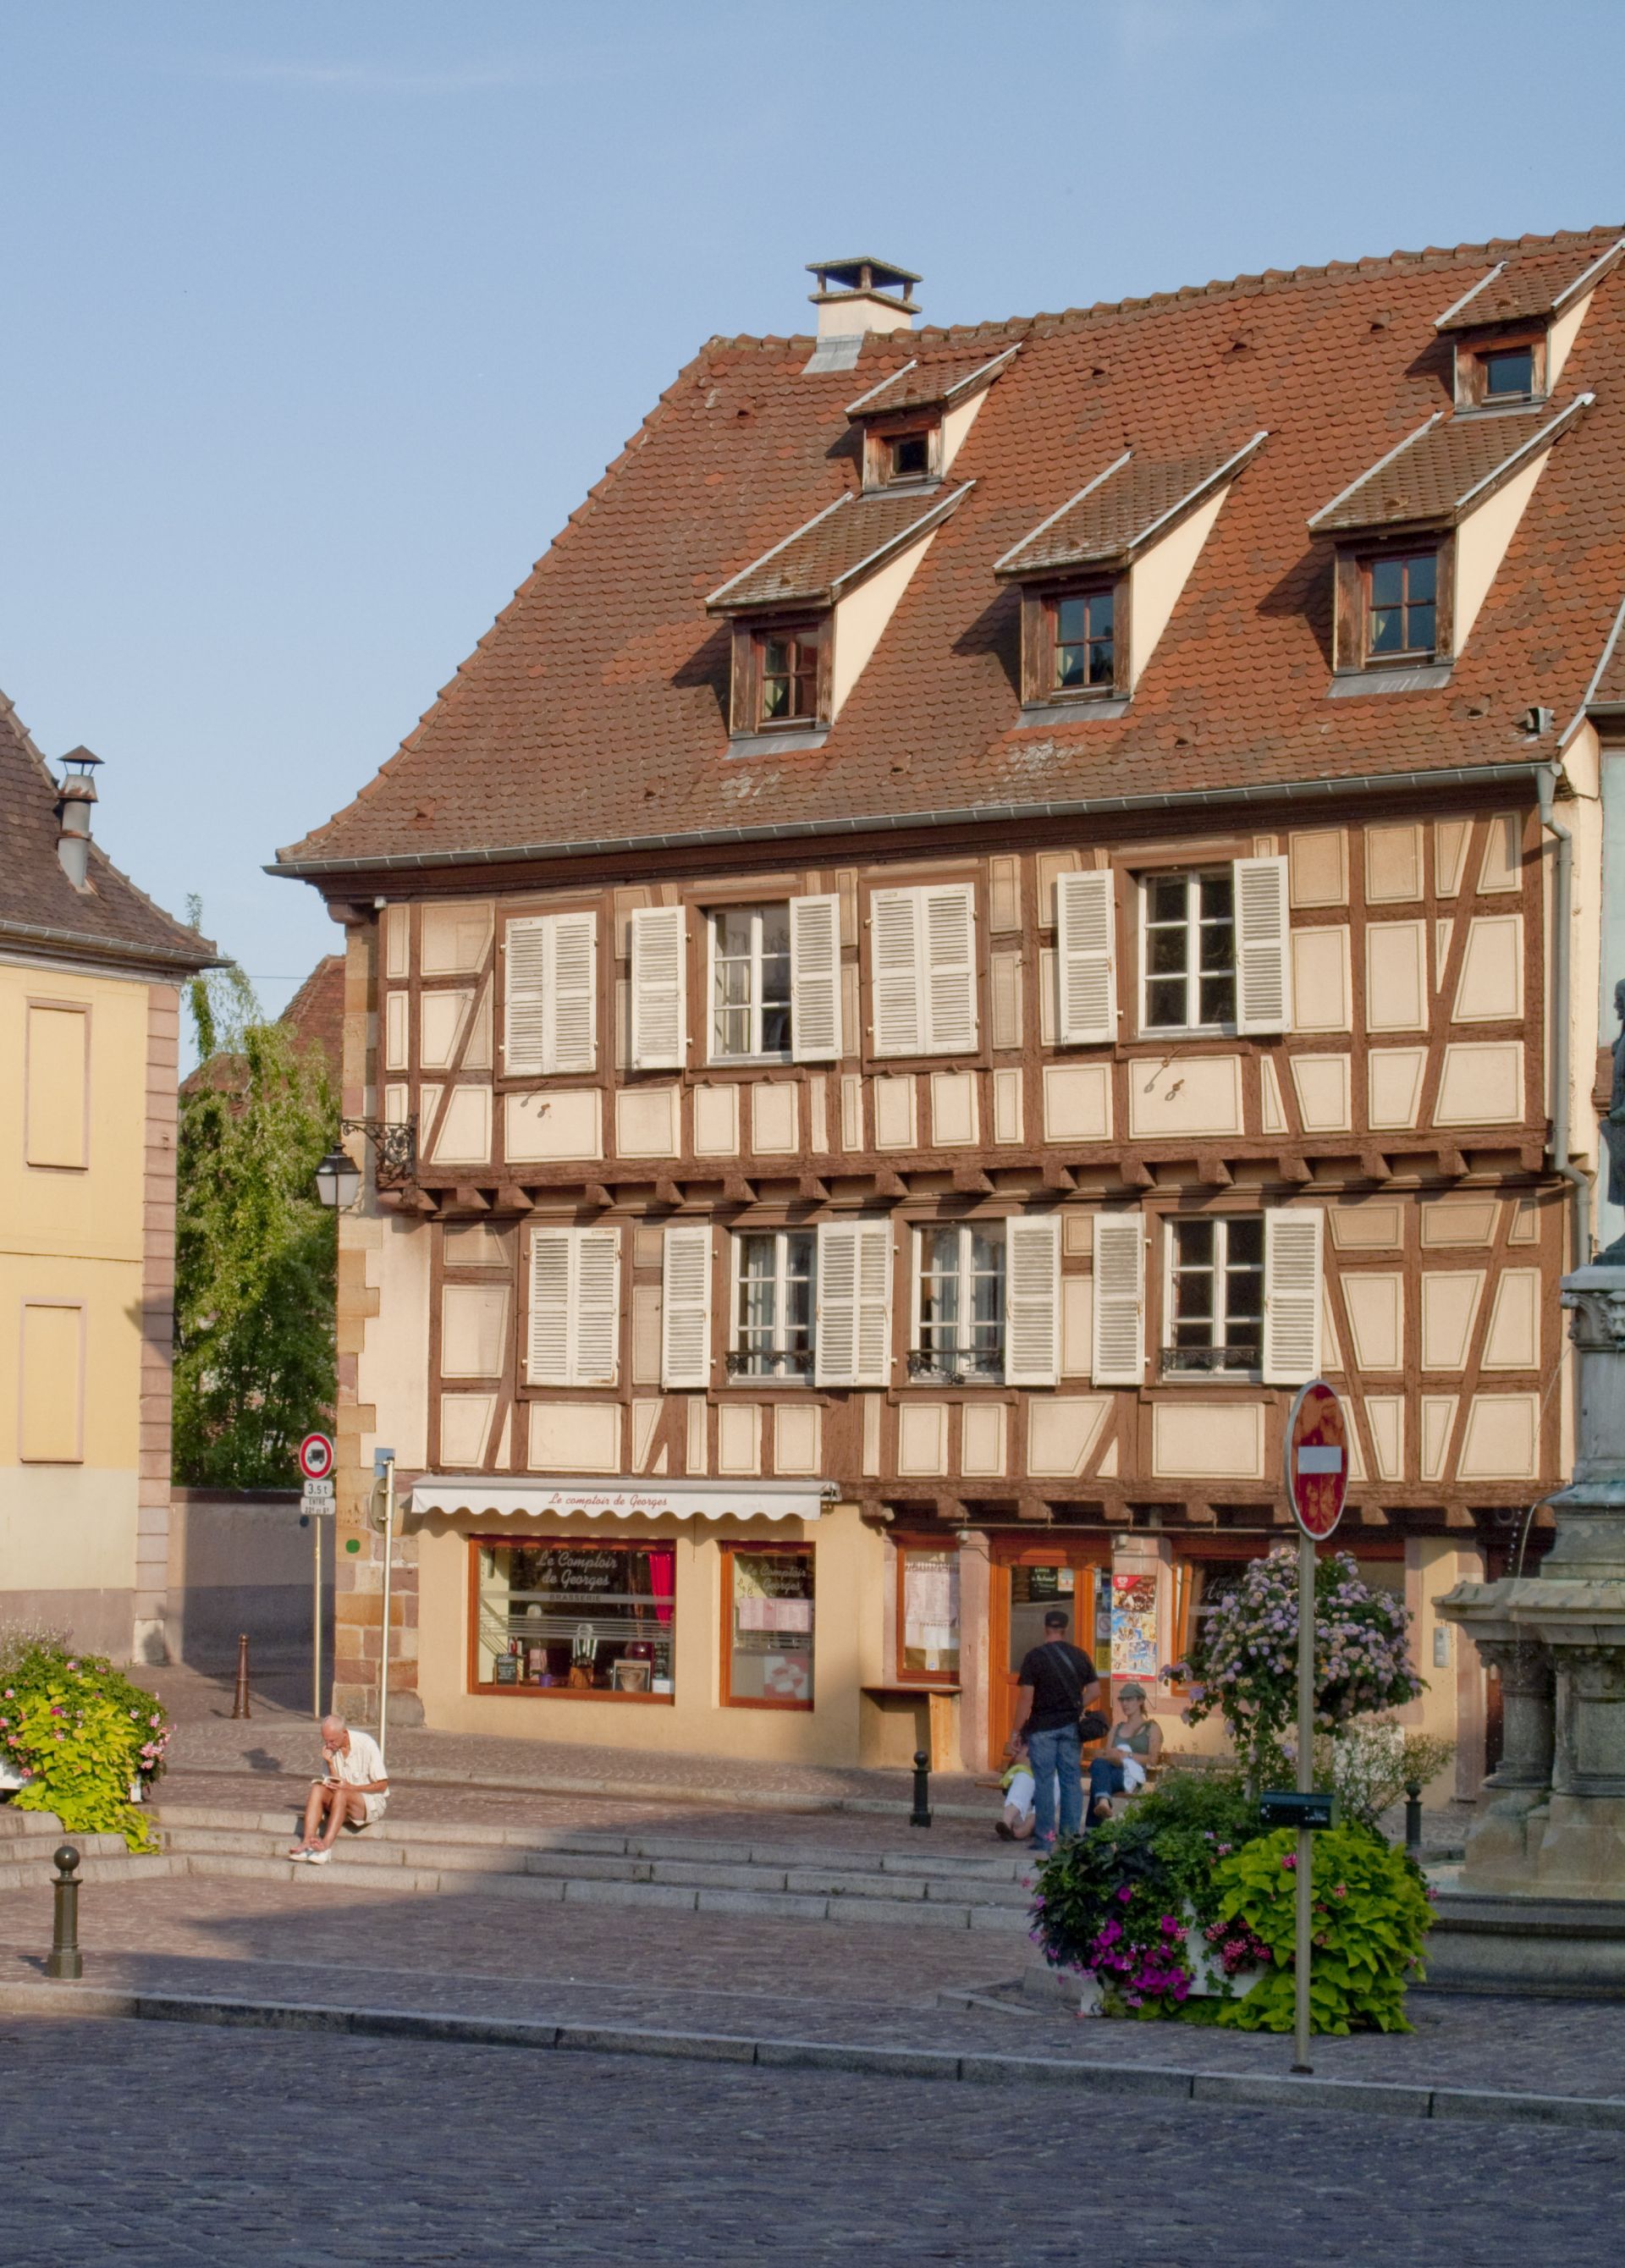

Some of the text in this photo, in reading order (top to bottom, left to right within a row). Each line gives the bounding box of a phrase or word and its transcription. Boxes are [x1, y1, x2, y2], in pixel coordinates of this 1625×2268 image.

[323, 1485, 328, 1495] t
[309, 1497, 325, 1506] ENTRE
[548, 1493, 668, 1510] Le comptoir de Georges
[536, 1551, 618, 1573] Le Comptoir
[542, 1567, 610, 1591] de Georges
[548, 1594, 603, 1603] BRASSERIE
